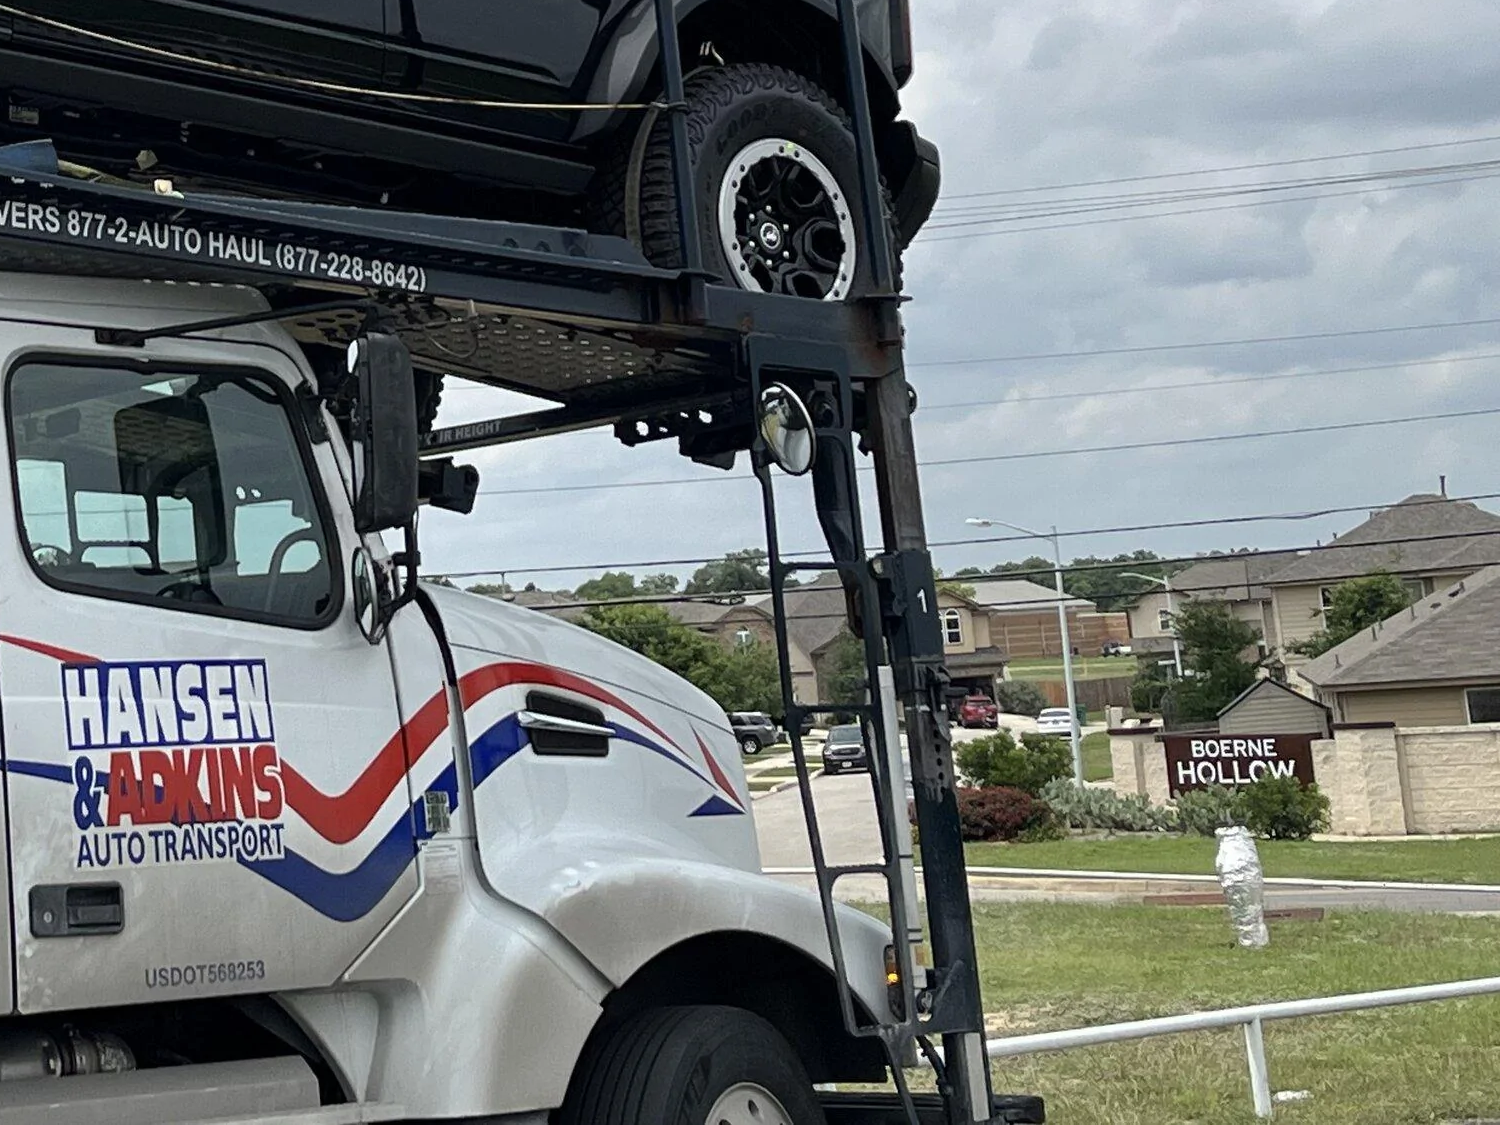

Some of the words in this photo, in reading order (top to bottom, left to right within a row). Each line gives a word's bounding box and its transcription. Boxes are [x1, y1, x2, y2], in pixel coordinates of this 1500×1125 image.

[67, 209, 202, 254] 877-2-AUTO
[208, 230, 272, 266] HAUL
[274, 242, 427, 292] (877-228-8642)
[455, 420, 501, 440] HEIGHT
[916, 588, 928, 614] 1
[64, 663, 272, 747] HANSEN
[1190, 738, 1278, 758] BOERNE
[1176, 759, 1296, 785] HOLLOW
[73, 755, 105, 830] &
[107, 745, 283, 827] ADKINS
[76, 831, 146, 868] AUTO
[148, 823, 285, 864] TRANSPORT
[145, 960, 266, 988] USDOT568253
